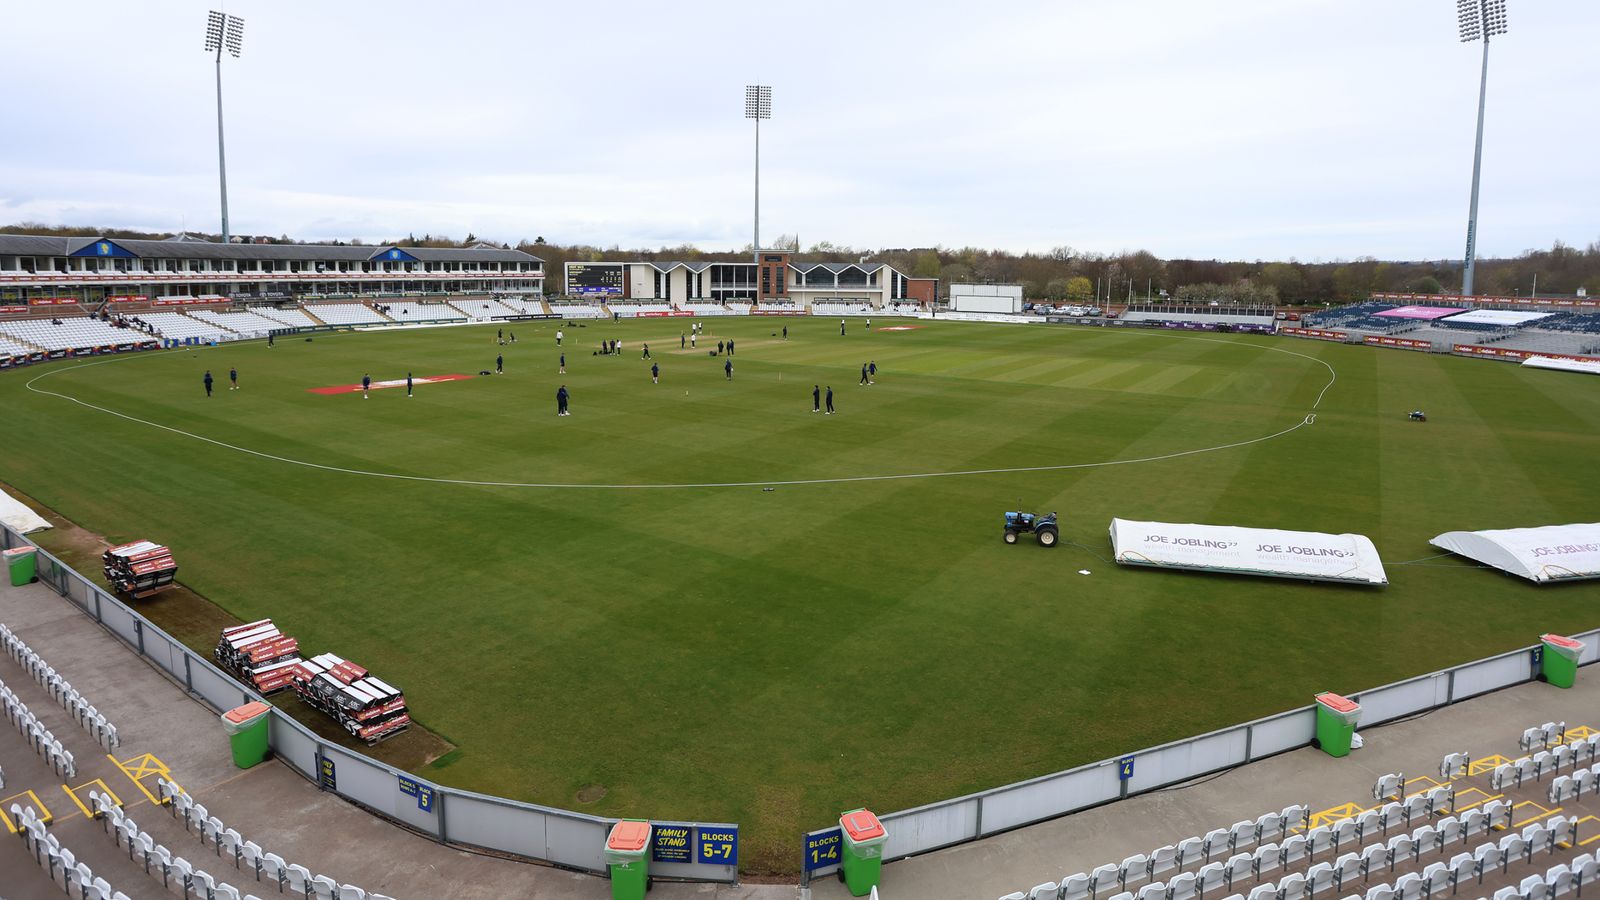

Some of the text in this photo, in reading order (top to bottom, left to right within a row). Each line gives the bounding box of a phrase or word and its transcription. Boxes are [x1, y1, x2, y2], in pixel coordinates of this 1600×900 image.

[1144, 535, 1168, 543] JOE
[1256, 544, 1282, 553] JOE
[1531, 546, 1556, 557] JOE
[1123, 763, 1130, 775] 4
[421, 794, 428, 807] 5
[656, 828, 688, 838] FAMILY
[701, 833, 734, 842] BLOCKS
[657, 838, 686, 847] STAND
[809, 835, 840, 848] BLOCKS
[703, 843, 733, 859] 5-7
[811, 845, 838, 864] 1-4
